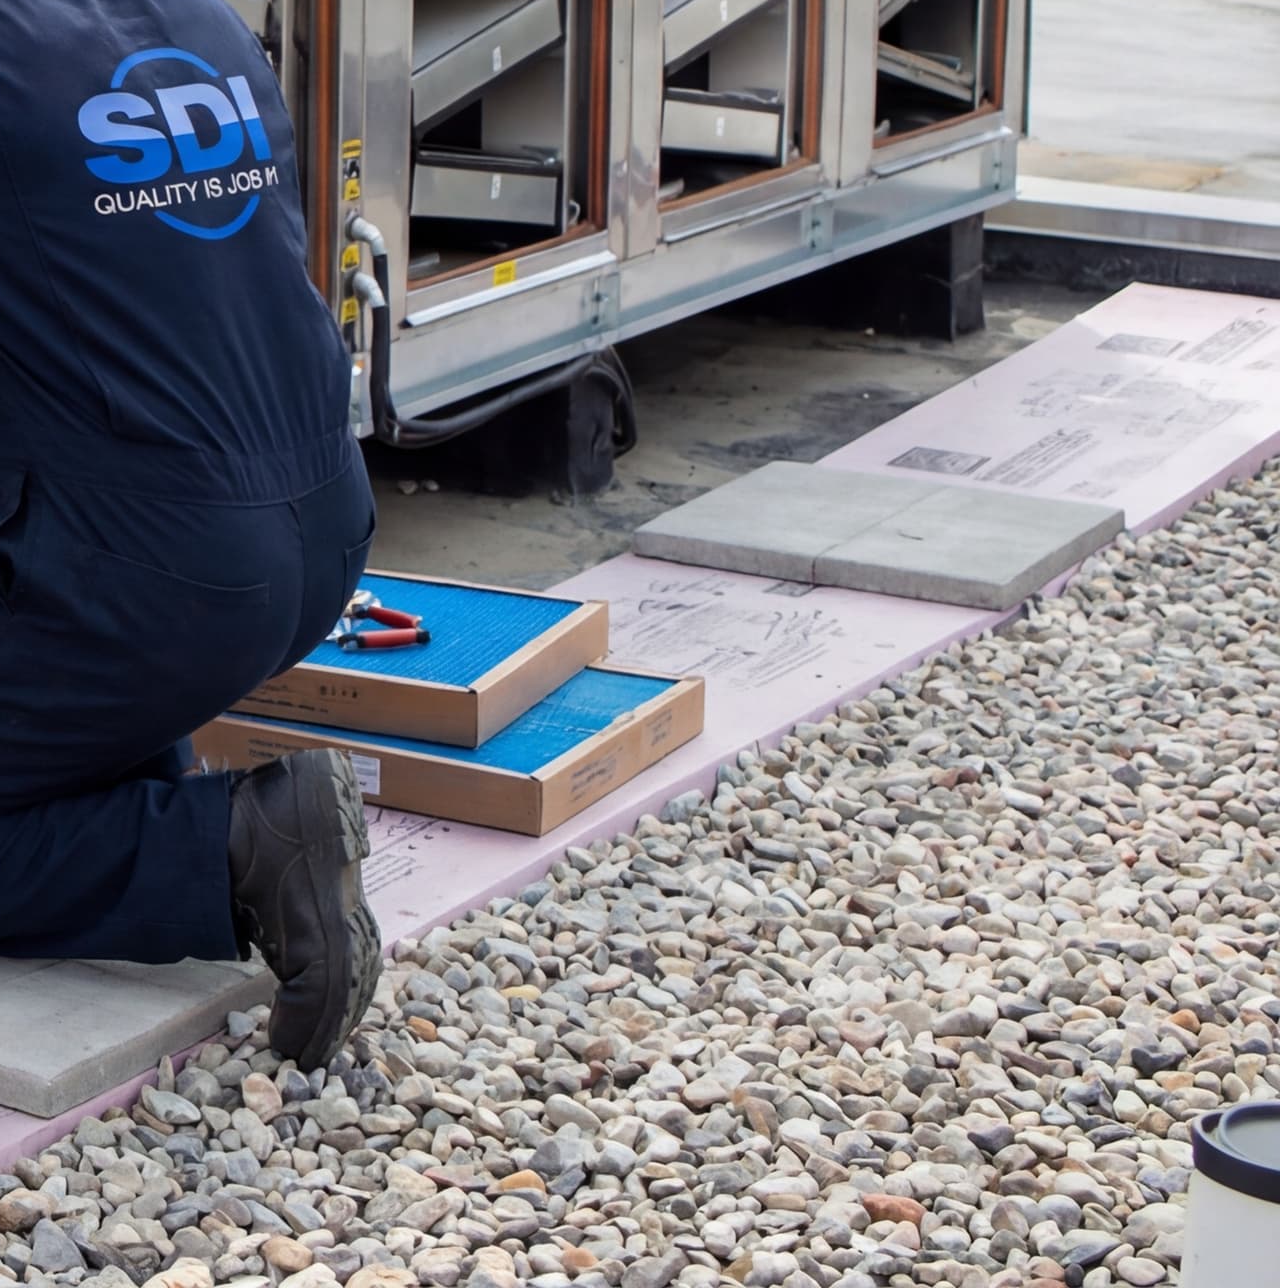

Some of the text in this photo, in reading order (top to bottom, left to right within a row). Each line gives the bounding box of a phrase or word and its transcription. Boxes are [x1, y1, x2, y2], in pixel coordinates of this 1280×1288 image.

[77, 75, 273, 184] SDI
[93, 180, 198, 215] QUALITY
[203, 177, 224, 199] IS
[227, 168, 263, 195] JOB
